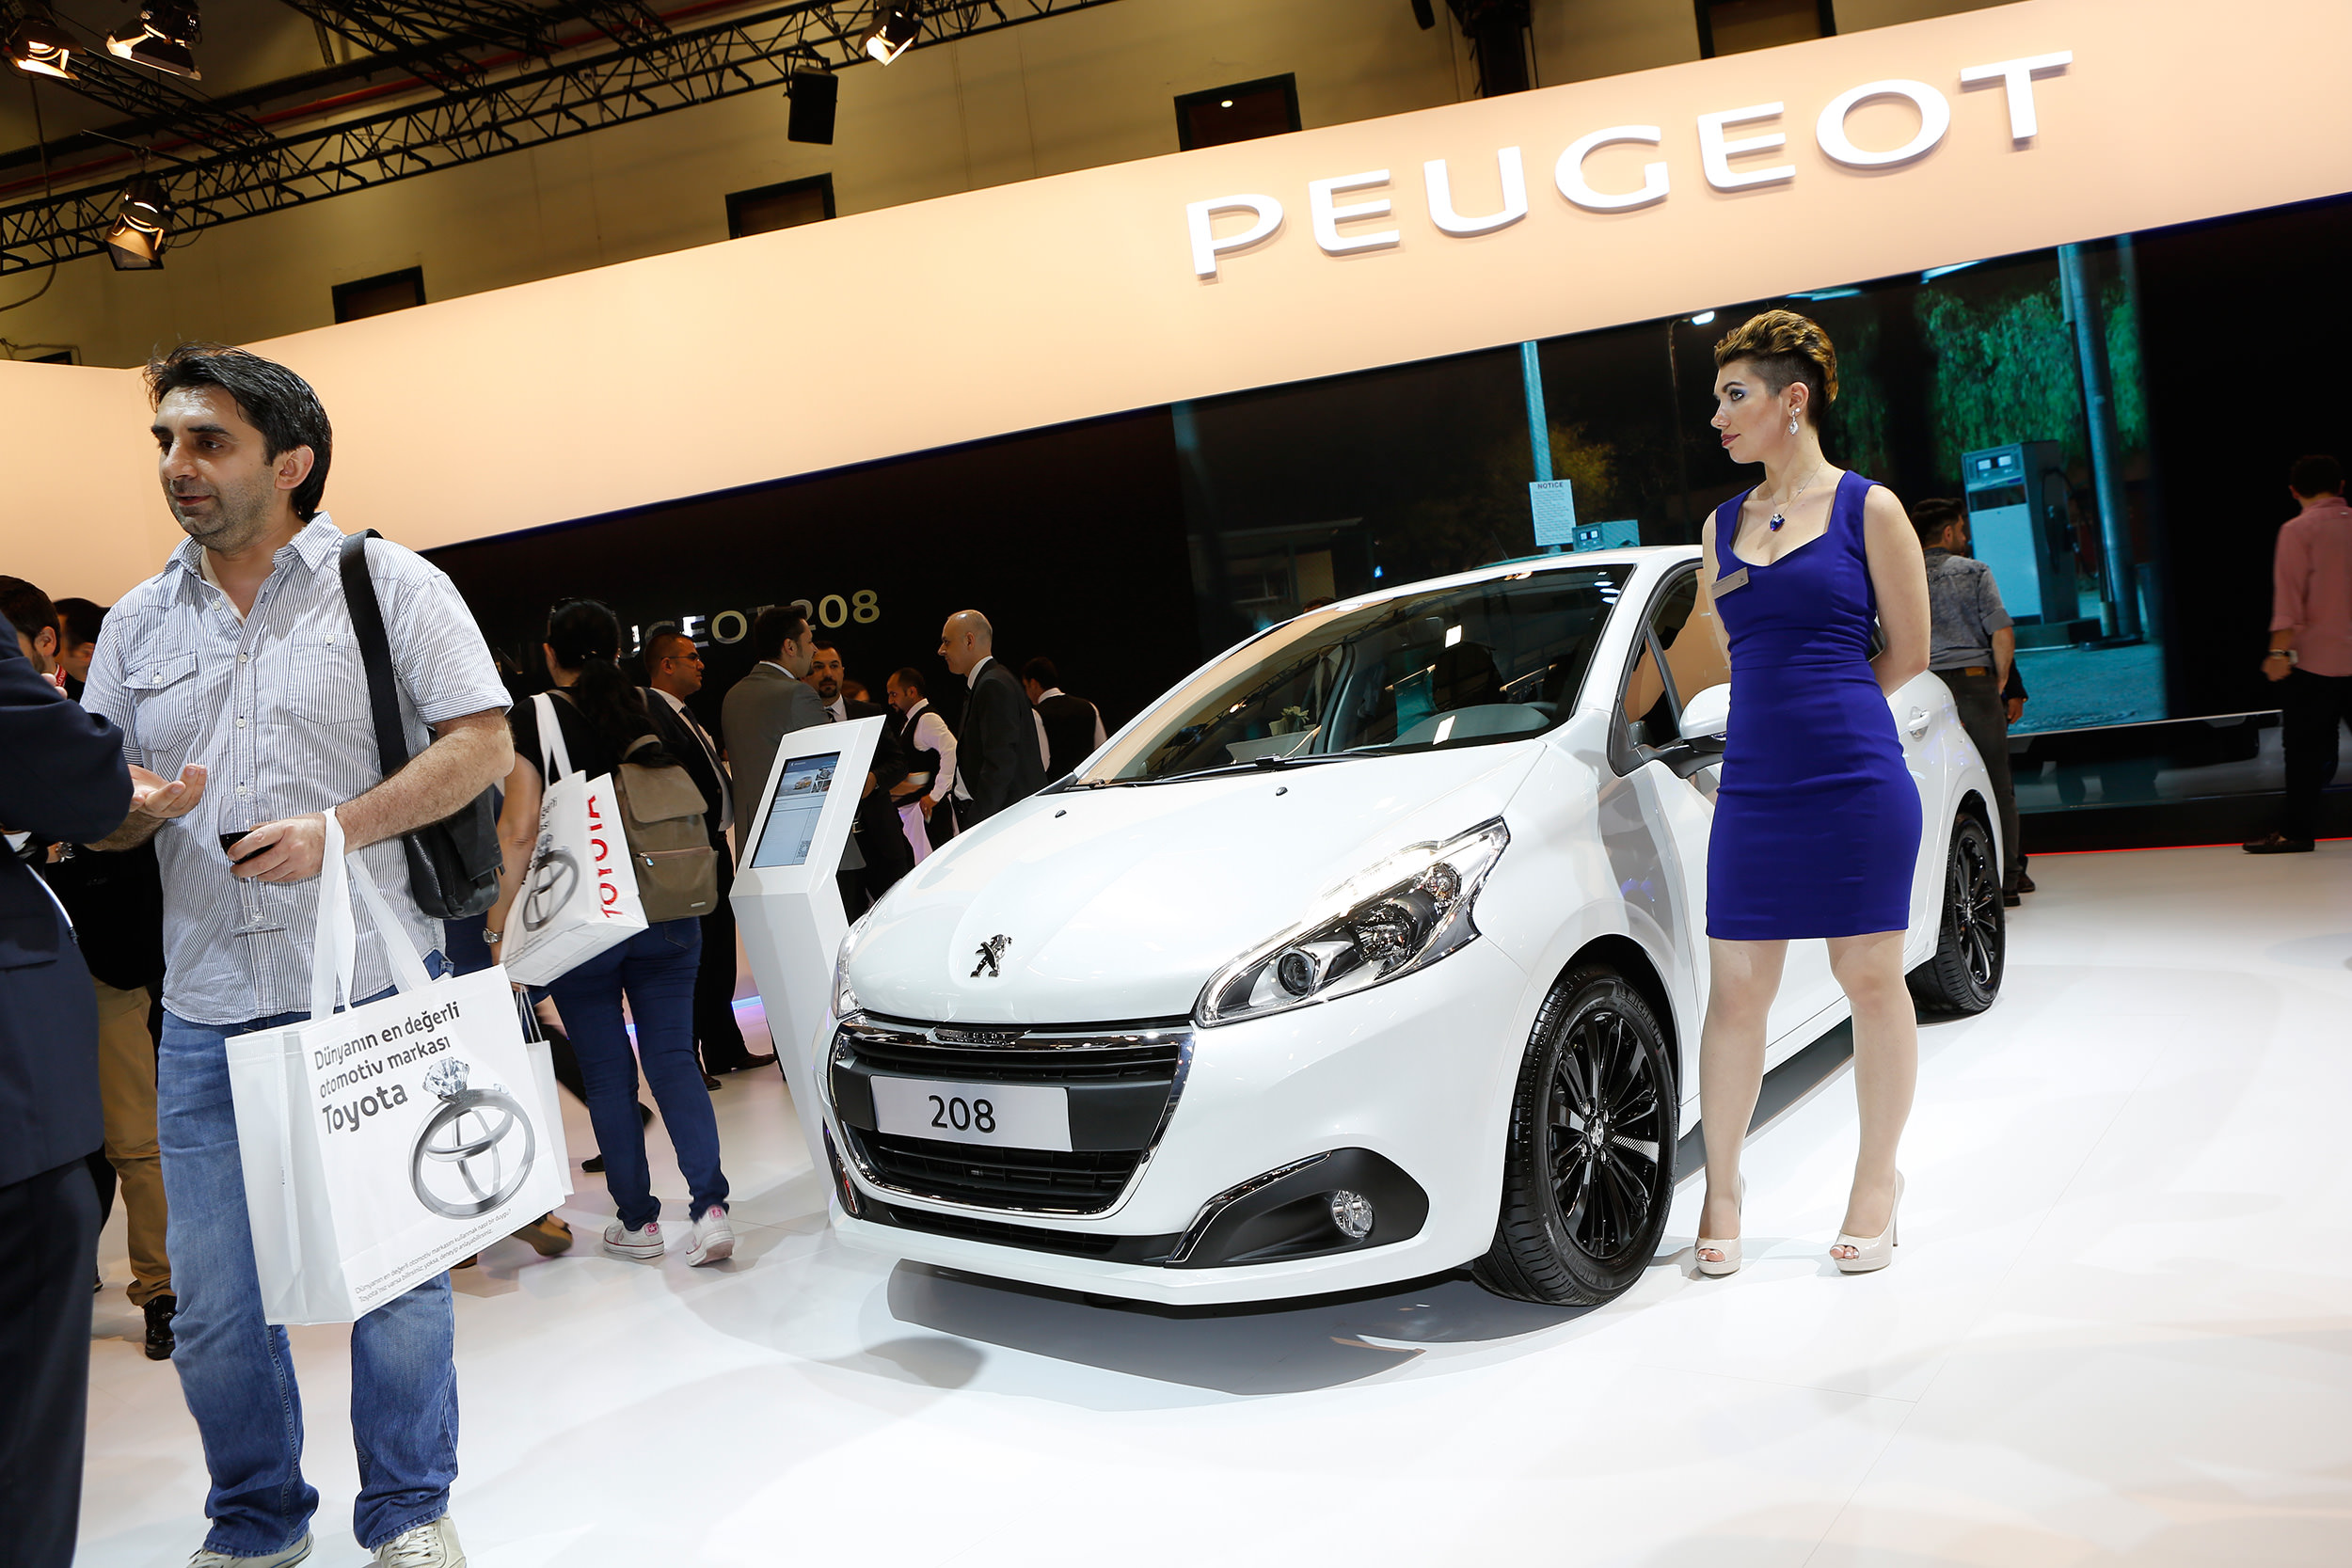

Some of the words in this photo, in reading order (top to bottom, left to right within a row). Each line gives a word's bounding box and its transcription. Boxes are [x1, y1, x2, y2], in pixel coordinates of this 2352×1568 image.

[1185, 50, 2074, 279] PEUGEOT
[314, 1033, 378, 1070] Dünyanın
[381, 1024, 403, 1042] en
[405, 1001, 460, 1033] değerli
[1626, 990, 1664, 1046] MICHELIN
[320, 1059, 383, 1099] otomotiv
[387, 1036, 451, 1069] markası
[322, 1083, 408, 1134] Toyota
[928, 1095, 997, 1133] 208
